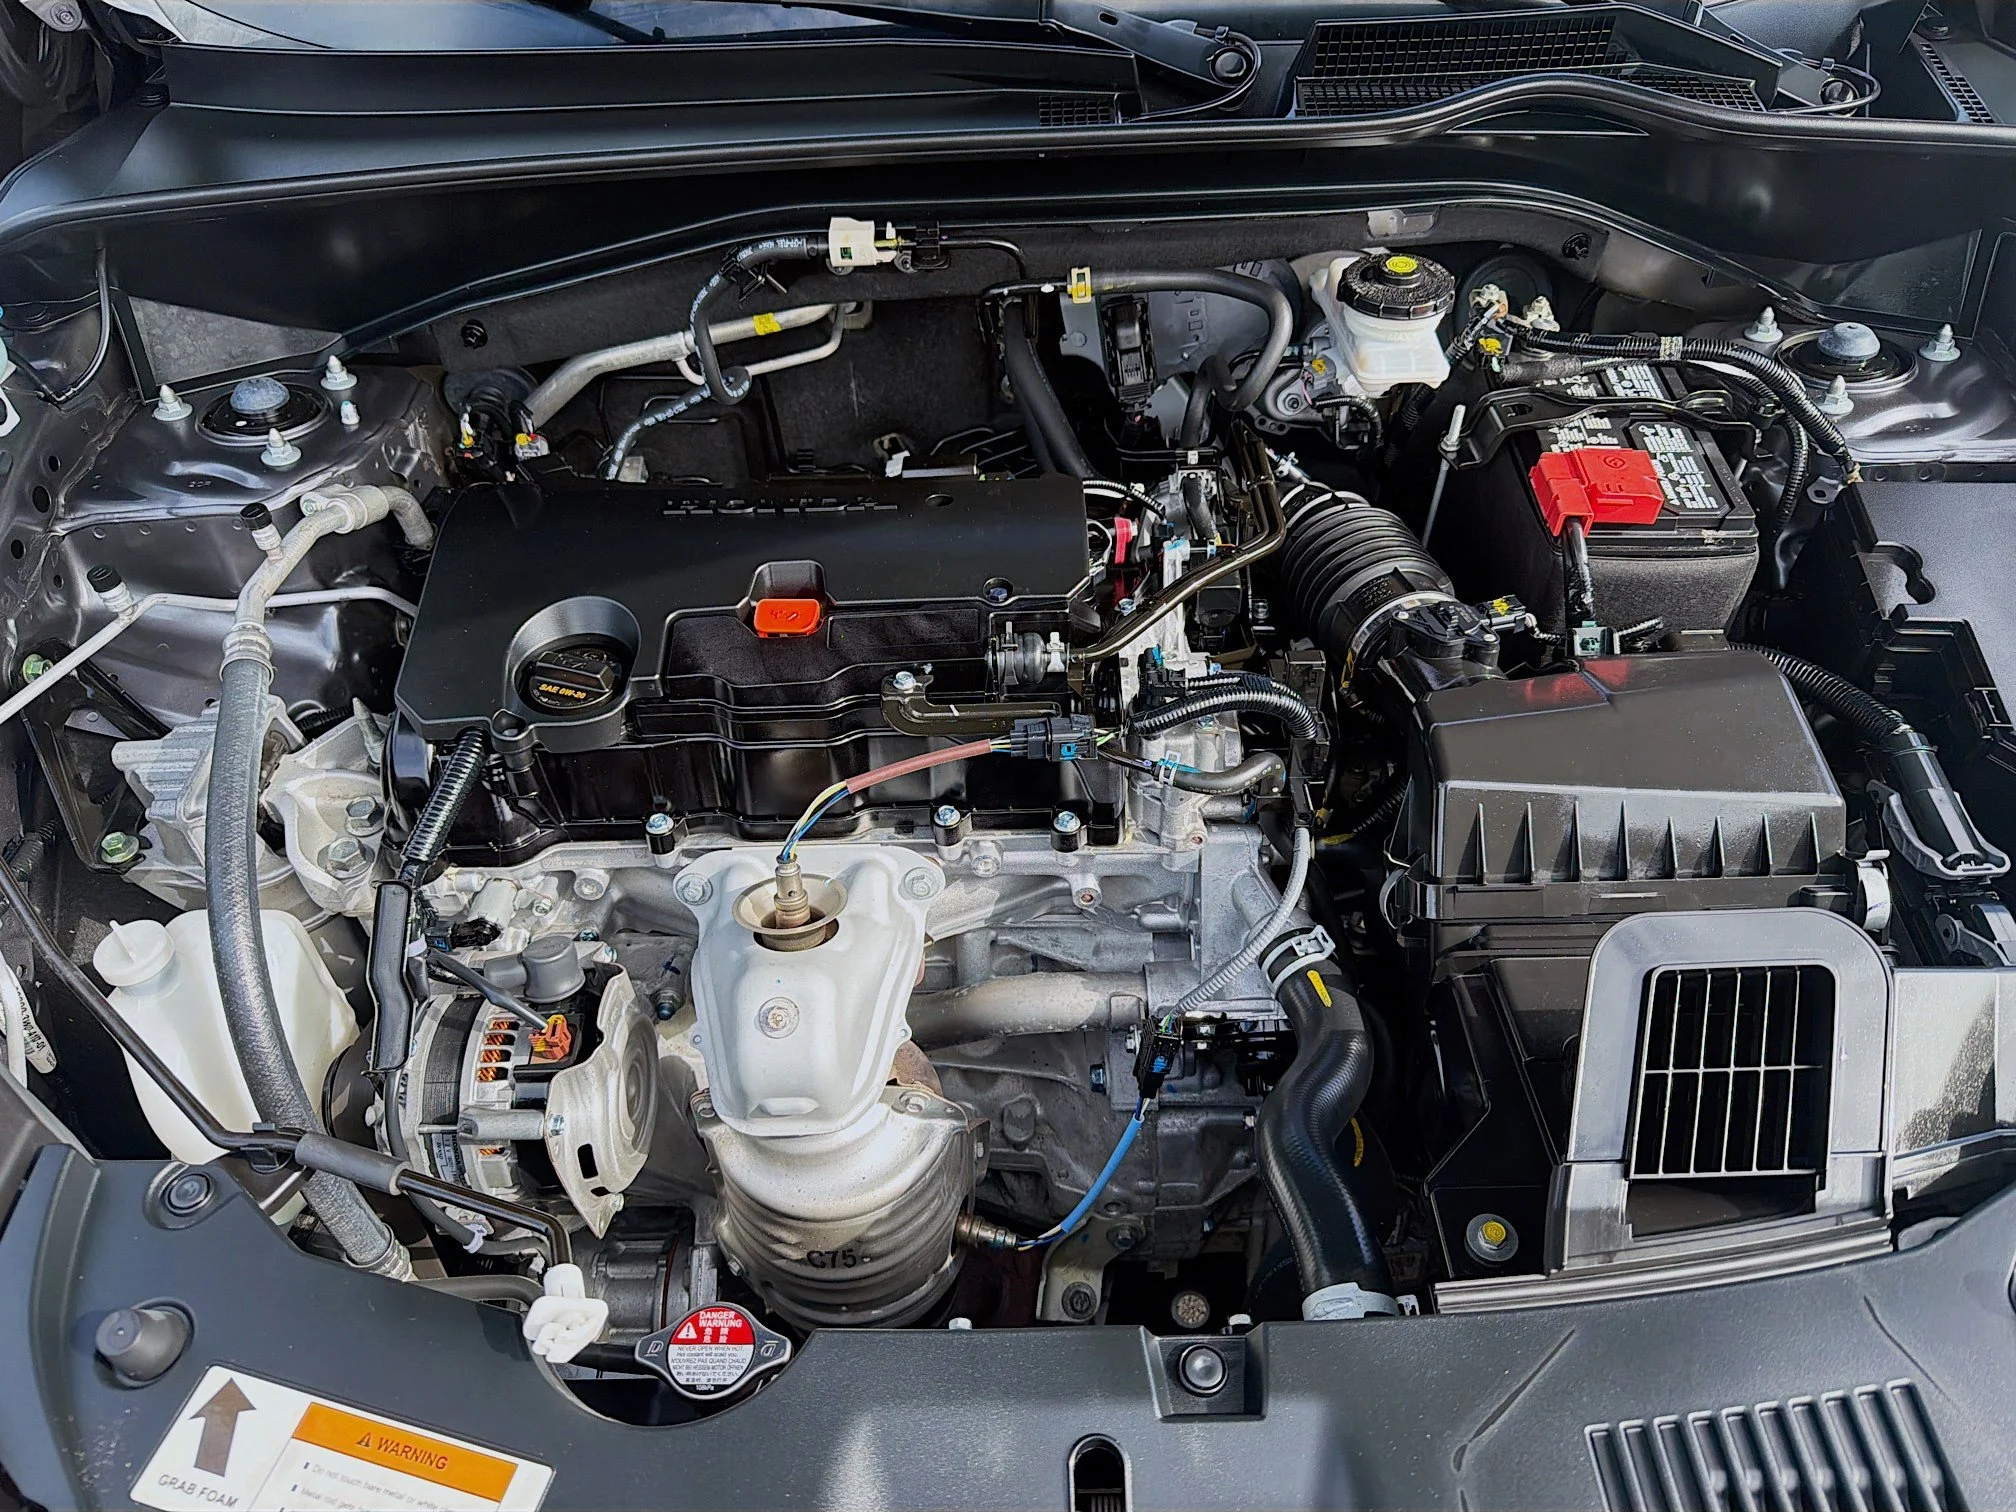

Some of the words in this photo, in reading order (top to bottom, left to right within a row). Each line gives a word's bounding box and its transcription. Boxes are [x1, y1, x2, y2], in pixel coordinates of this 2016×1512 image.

[539, 683, 560, 694] SAE
[559, 688, 587, 699] 0W-20
[806, 1248, 857, 1269] C75
[699, 1319, 742, 1328] WARNUNG
[700, 1311, 735, 1319] DANGER
[377, 1437, 449, 1470] WARNING
[158, 1474, 197, 1495] GRAB
[198, 1487, 239, 1508] FOAM
[325, 1469, 339, 1480] not
[340, 1474, 362, 1486] touch
[363, 1481, 382, 1493] bare
[382, 1488, 406, 1500] metal
